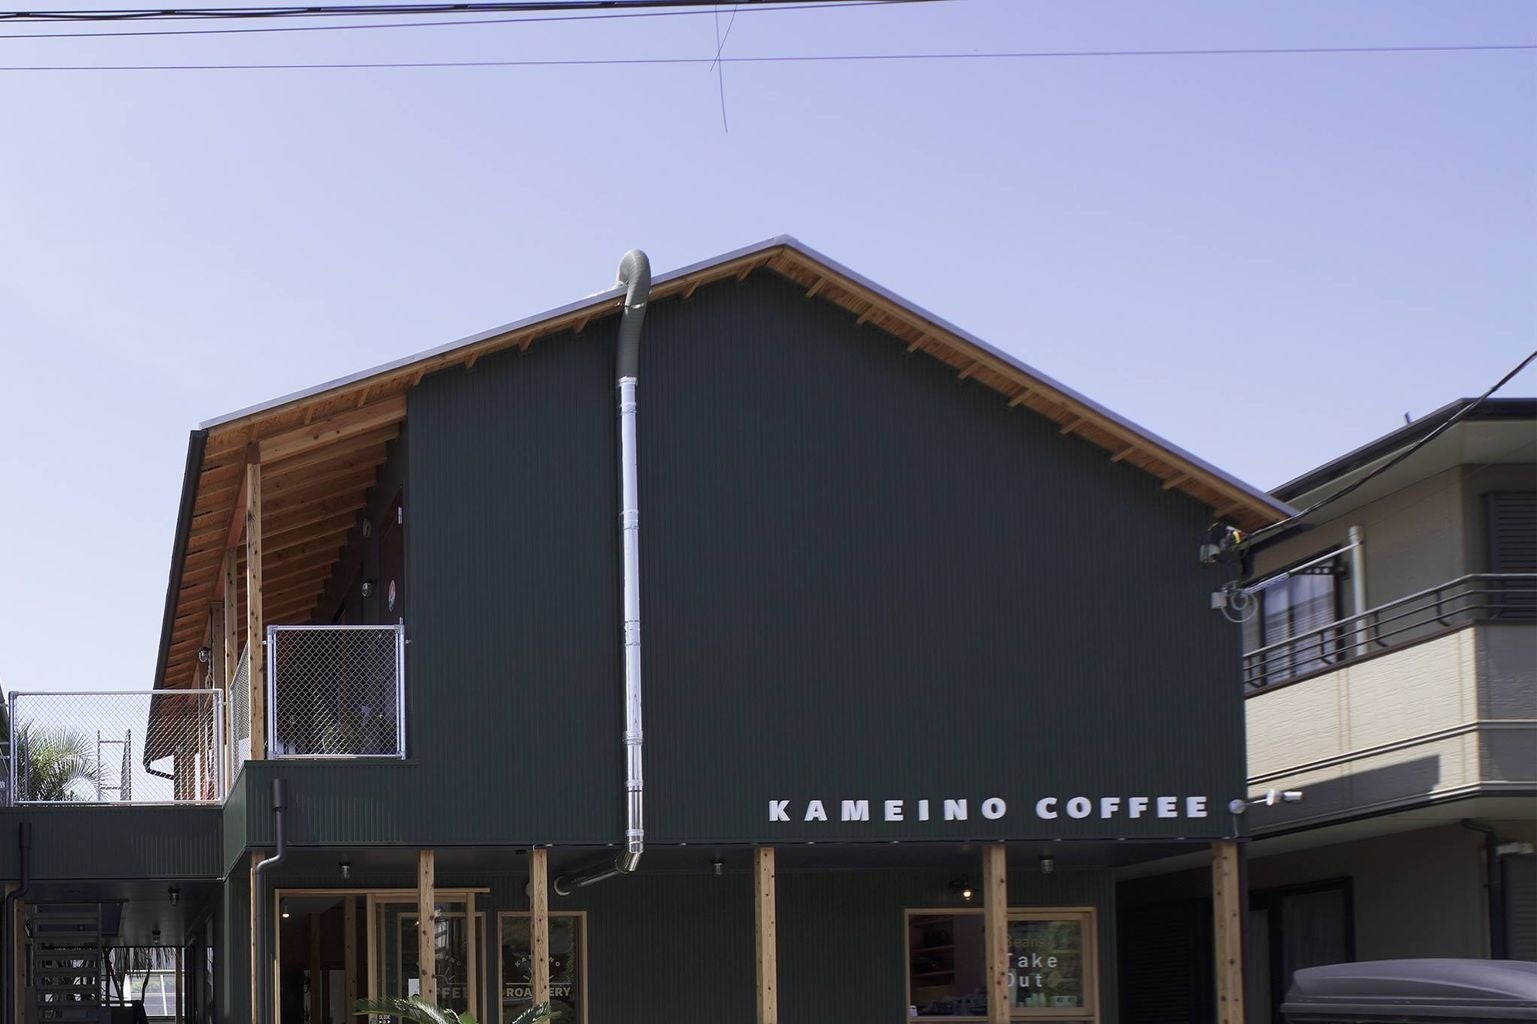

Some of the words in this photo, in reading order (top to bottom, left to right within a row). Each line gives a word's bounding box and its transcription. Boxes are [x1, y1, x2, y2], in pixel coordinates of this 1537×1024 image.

[768, 797, 1006, 822] KAMEINO
[1035, 796, 1207, 820] COFFEE
[506, 987, 571, 997] ROAERY
